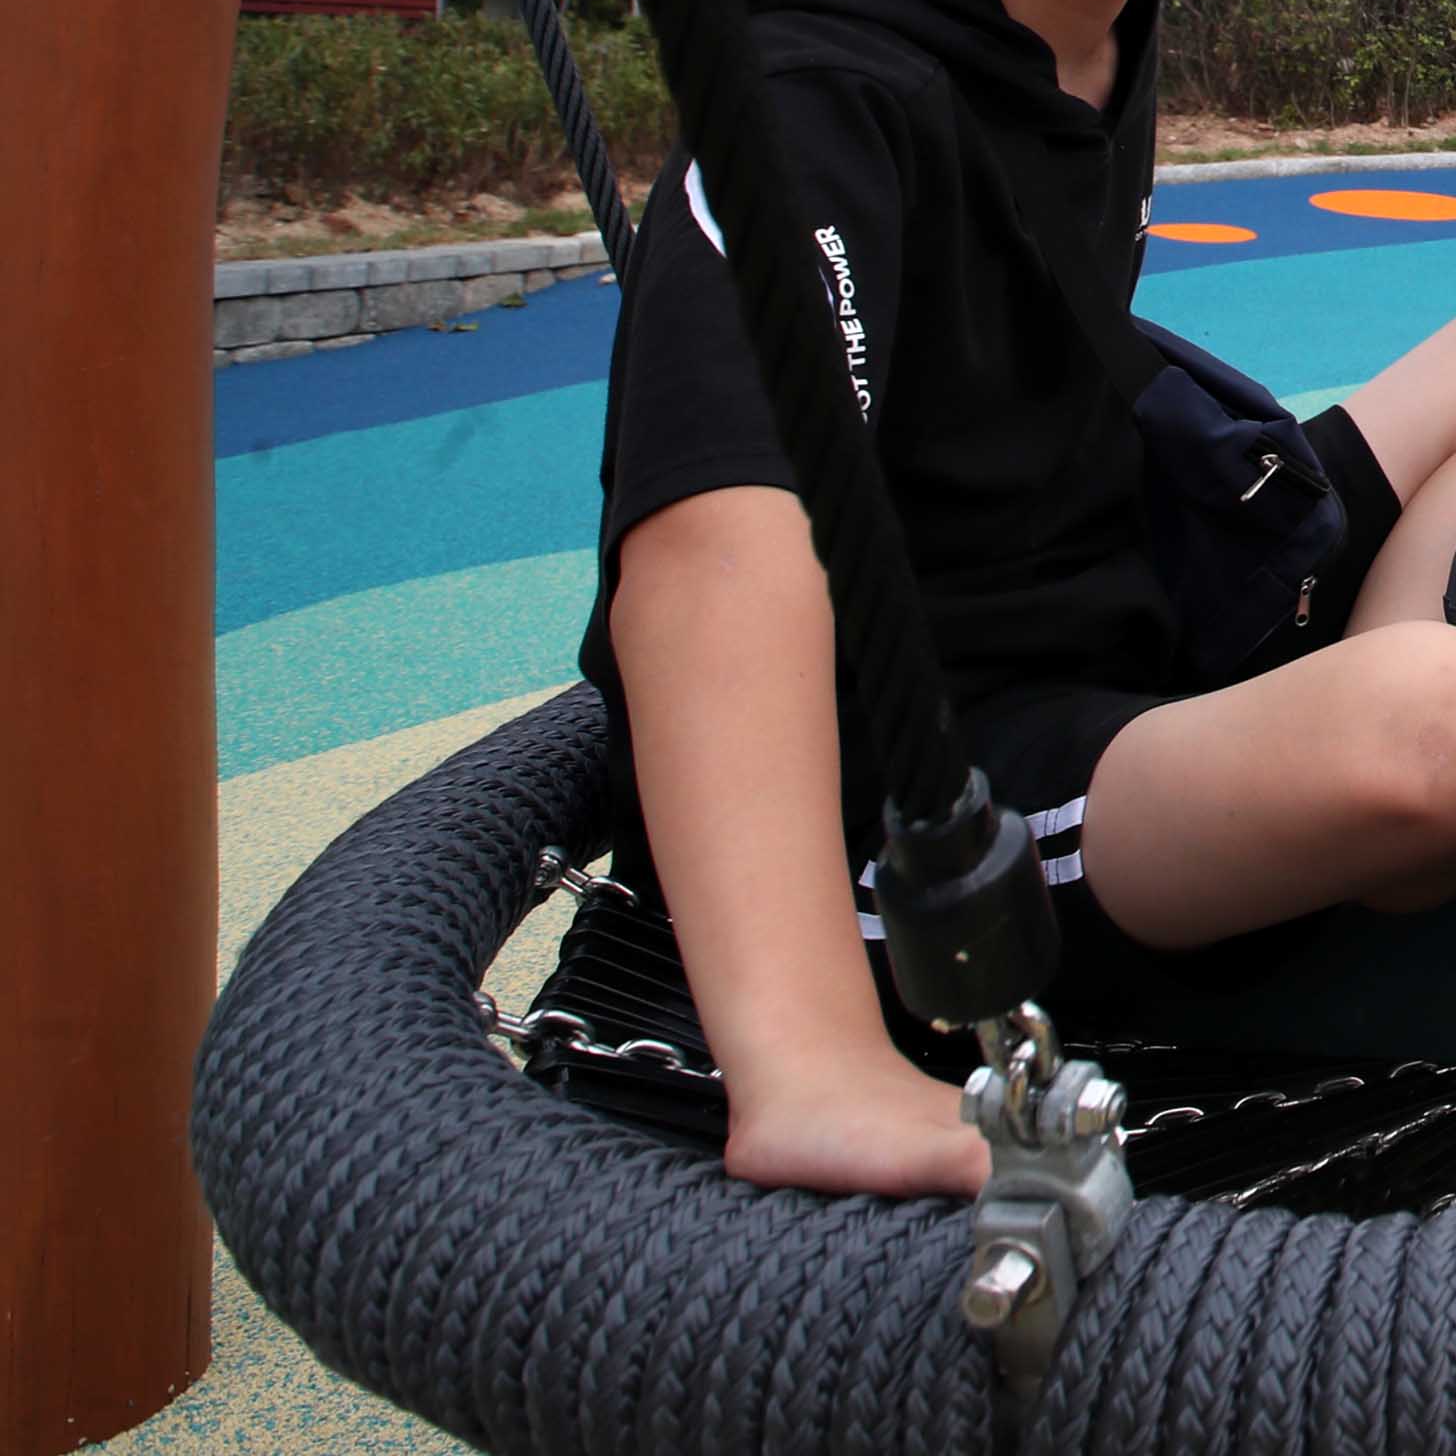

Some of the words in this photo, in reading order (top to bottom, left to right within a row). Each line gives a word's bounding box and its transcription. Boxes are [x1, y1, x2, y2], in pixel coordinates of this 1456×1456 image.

[814, 225, 856, 317] POWER
[841, 318, 867, 371] THE
[850, 374, 871, 424] OT
